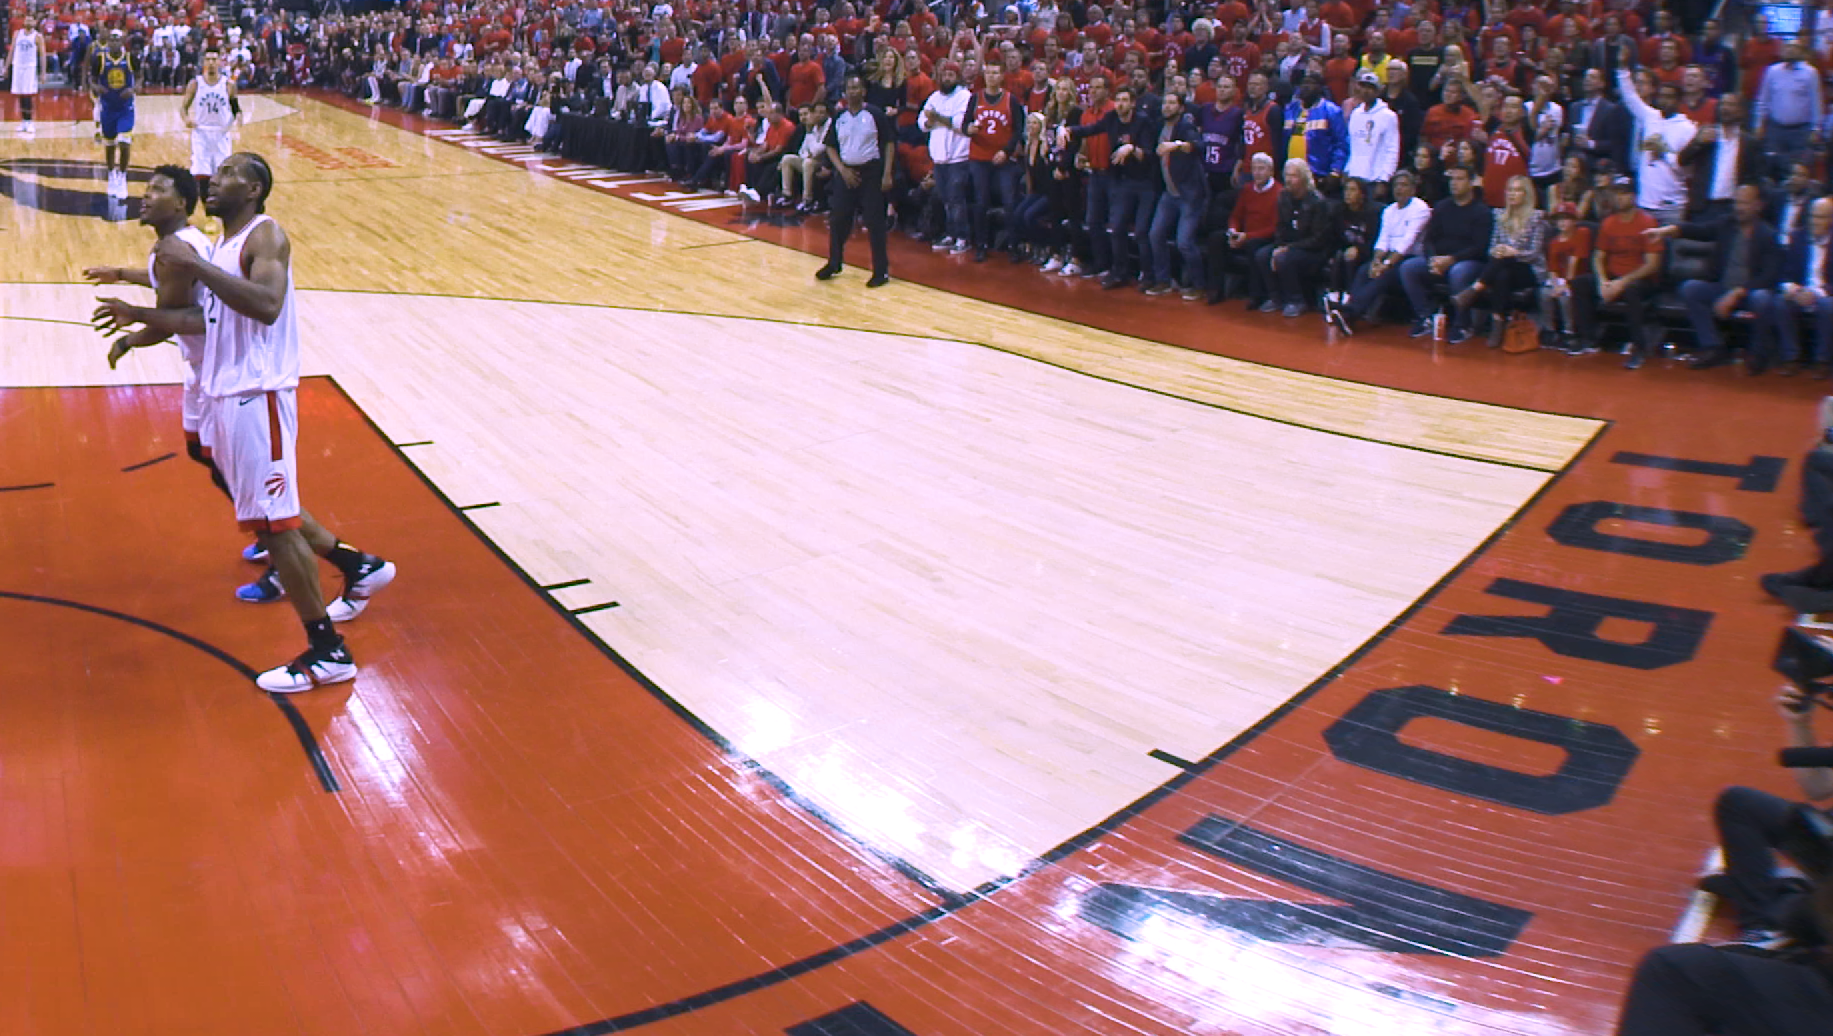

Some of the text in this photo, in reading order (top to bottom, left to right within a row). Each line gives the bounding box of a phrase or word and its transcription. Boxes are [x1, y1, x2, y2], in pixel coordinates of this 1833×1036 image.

[206, 101, 220, 114] 14
[987, 119, 998, 135] 2
[1204, 145, 1221, 165] 15
[1494, 149, 1510, 165] 17
